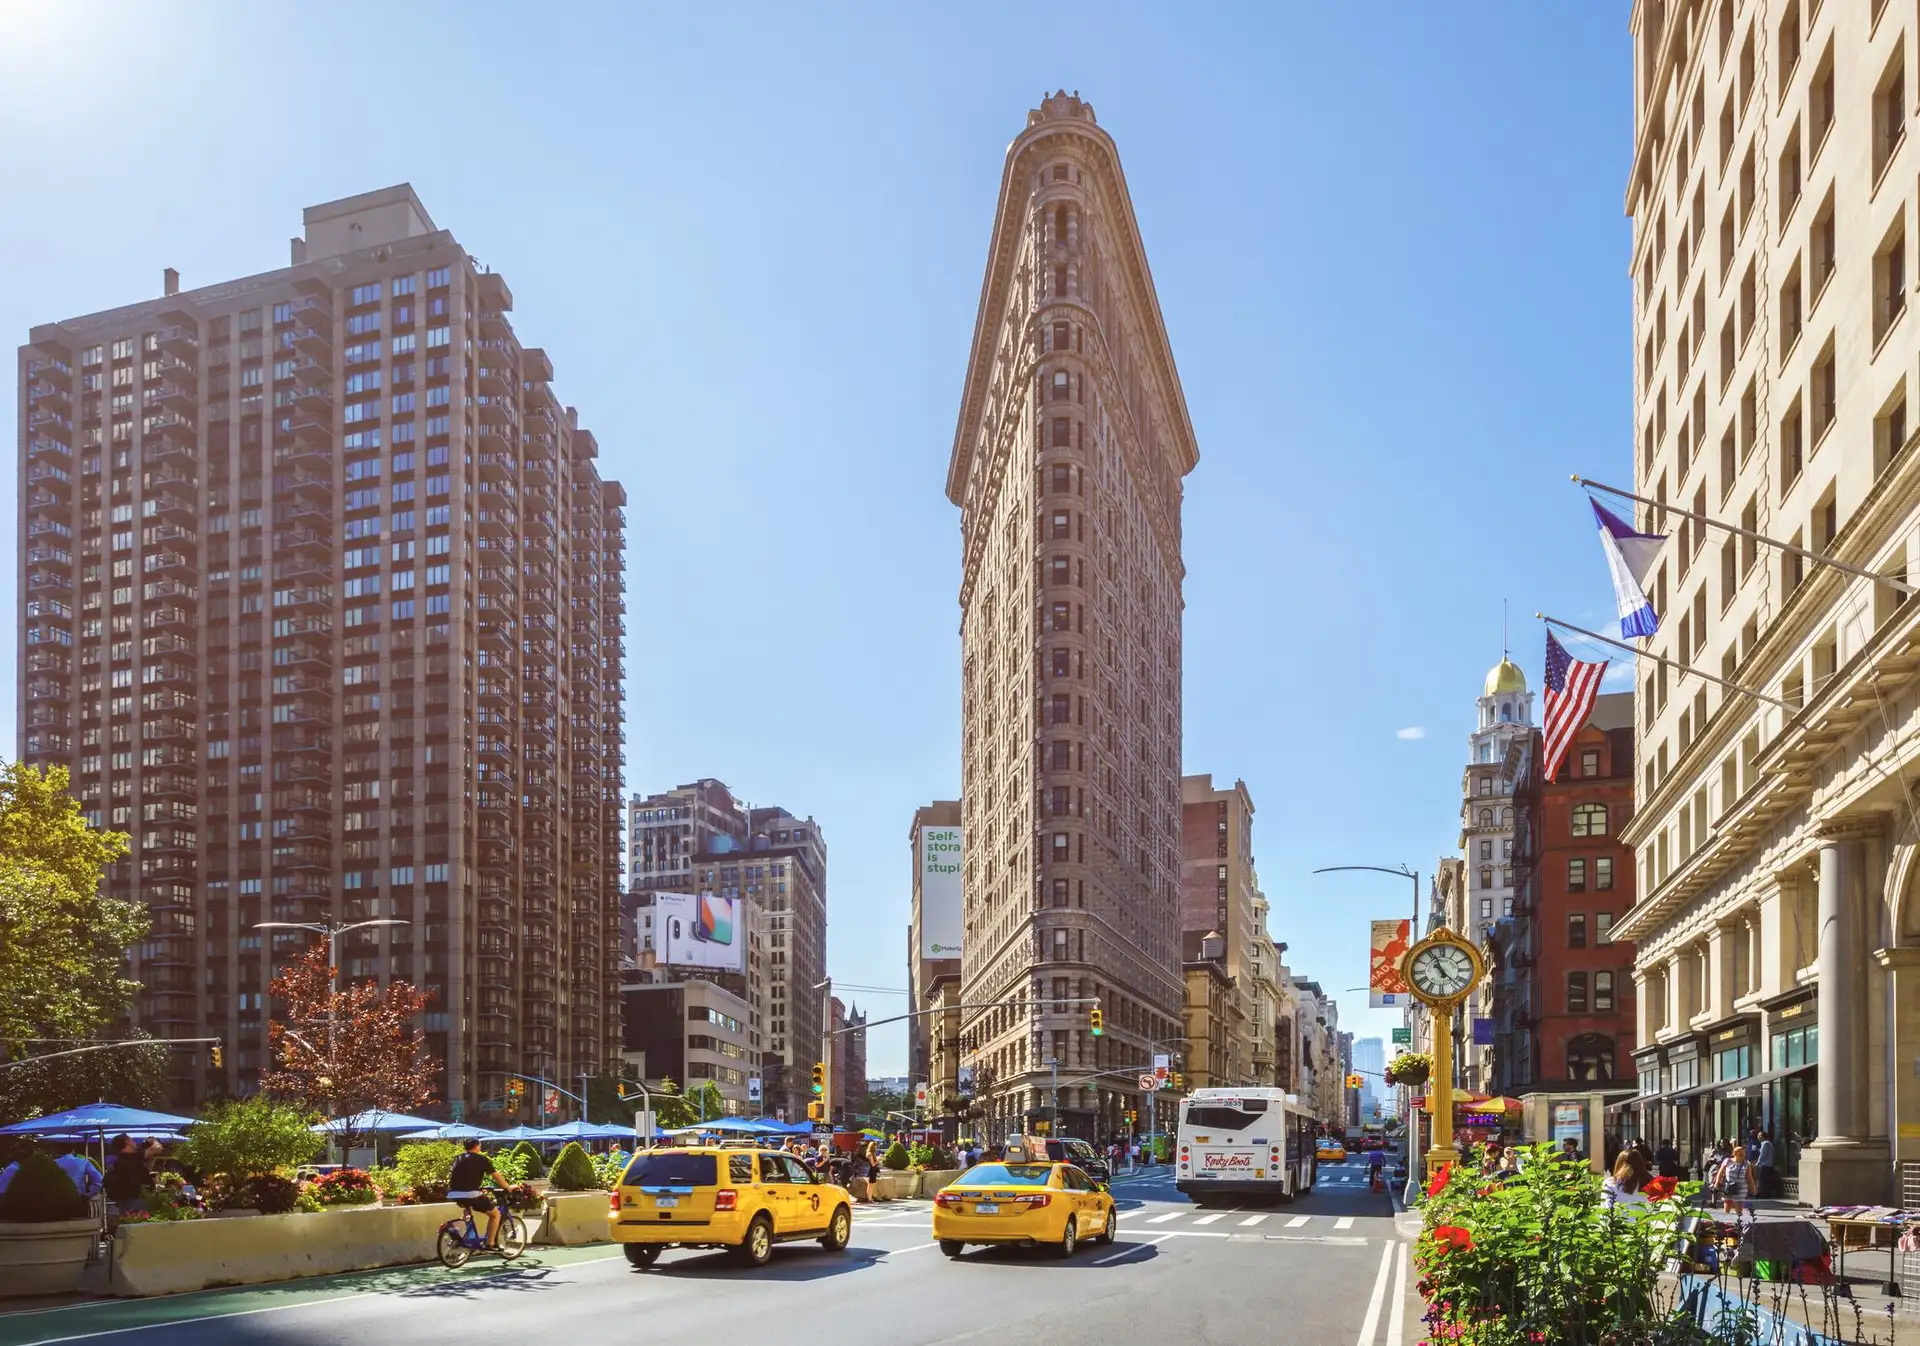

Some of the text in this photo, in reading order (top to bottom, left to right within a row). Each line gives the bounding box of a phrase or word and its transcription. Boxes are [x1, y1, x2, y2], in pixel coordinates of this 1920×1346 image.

[928, 831, 959, 840] Self-
[928, 842, 961, 851] stora
[928, 852, 938, 861] is
[928, 863, 961, 875] stupi
[1204, 1155, 1252, 1168] Kinky Boots
